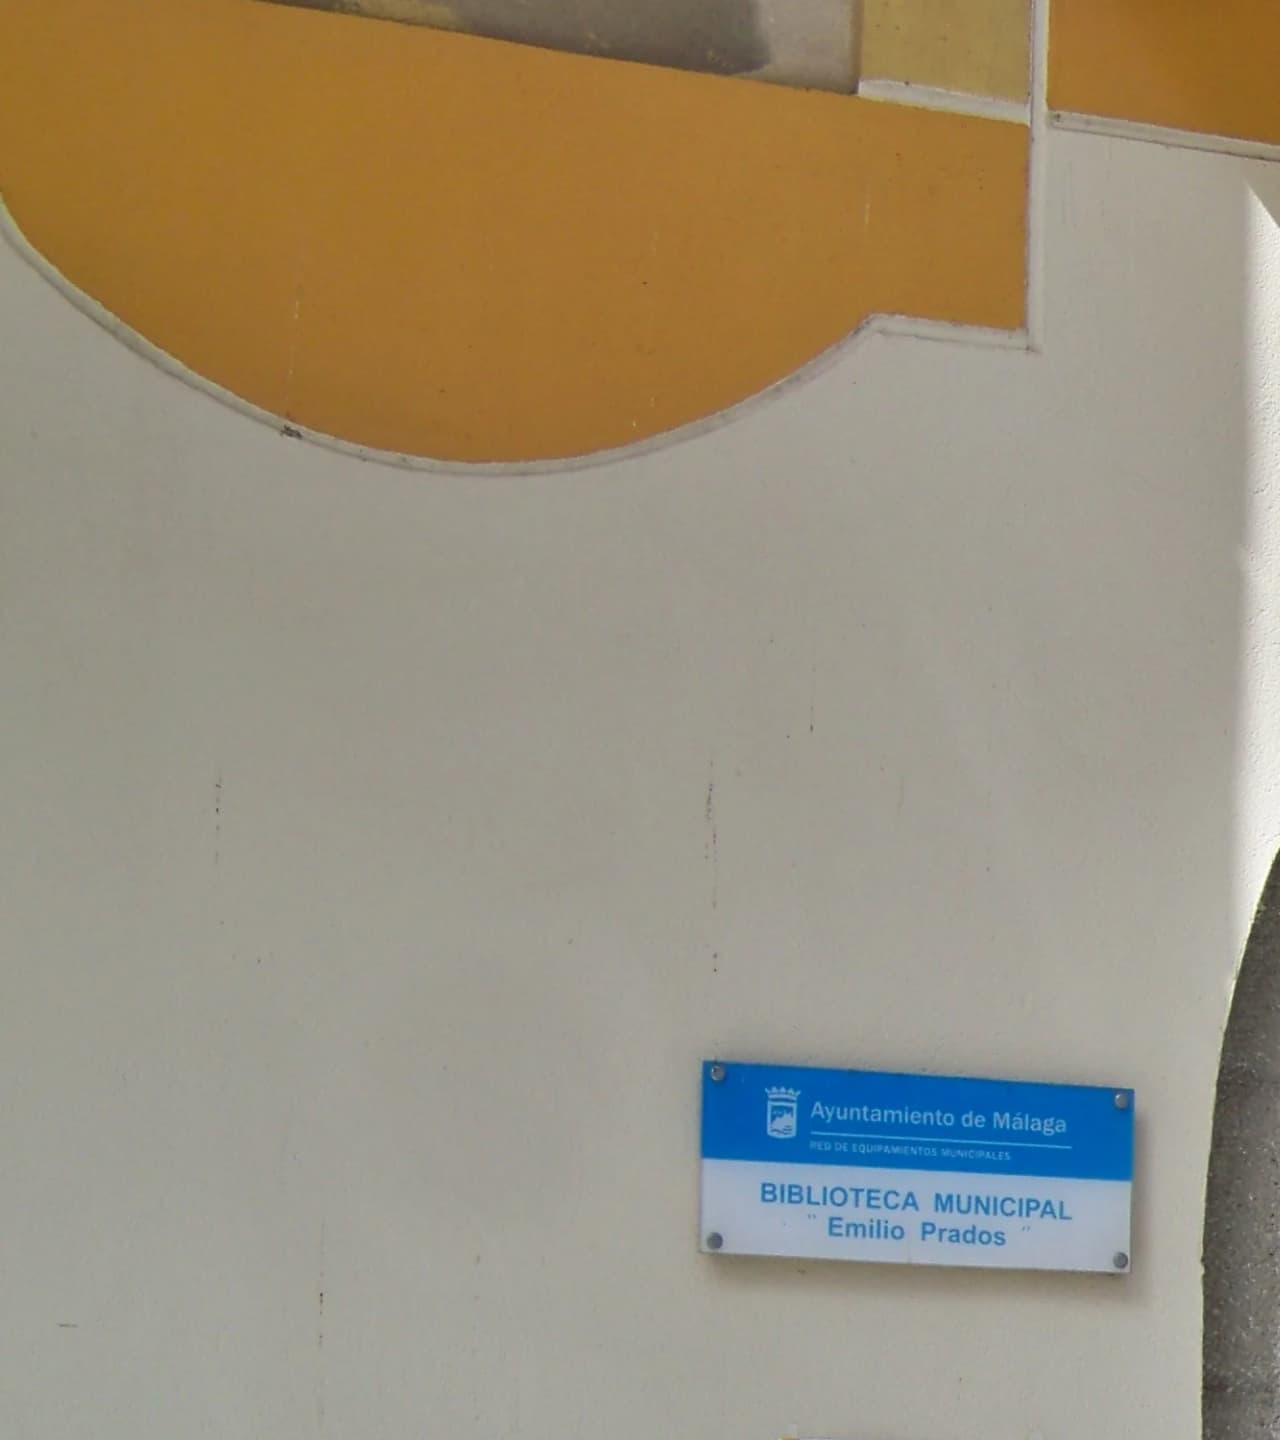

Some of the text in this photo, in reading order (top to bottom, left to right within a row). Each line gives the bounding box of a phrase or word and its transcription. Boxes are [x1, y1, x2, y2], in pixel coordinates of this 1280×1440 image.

[810, 1101, 1067, 1135] Ayuntamiento de Málaga
[834, 1142, 849, 1153] DE
[852, 1143, 938, 1158] EQUIPAMIENTOS
[941, 1148, 1012, 1162] MUNICIPALES
[760, 1182, 1073, 1221] BIBLIOTECA MUNICIPAL
[827, 1216, 905, 1241] Emilio
[920, 1221, 1006, 1246] Prados
